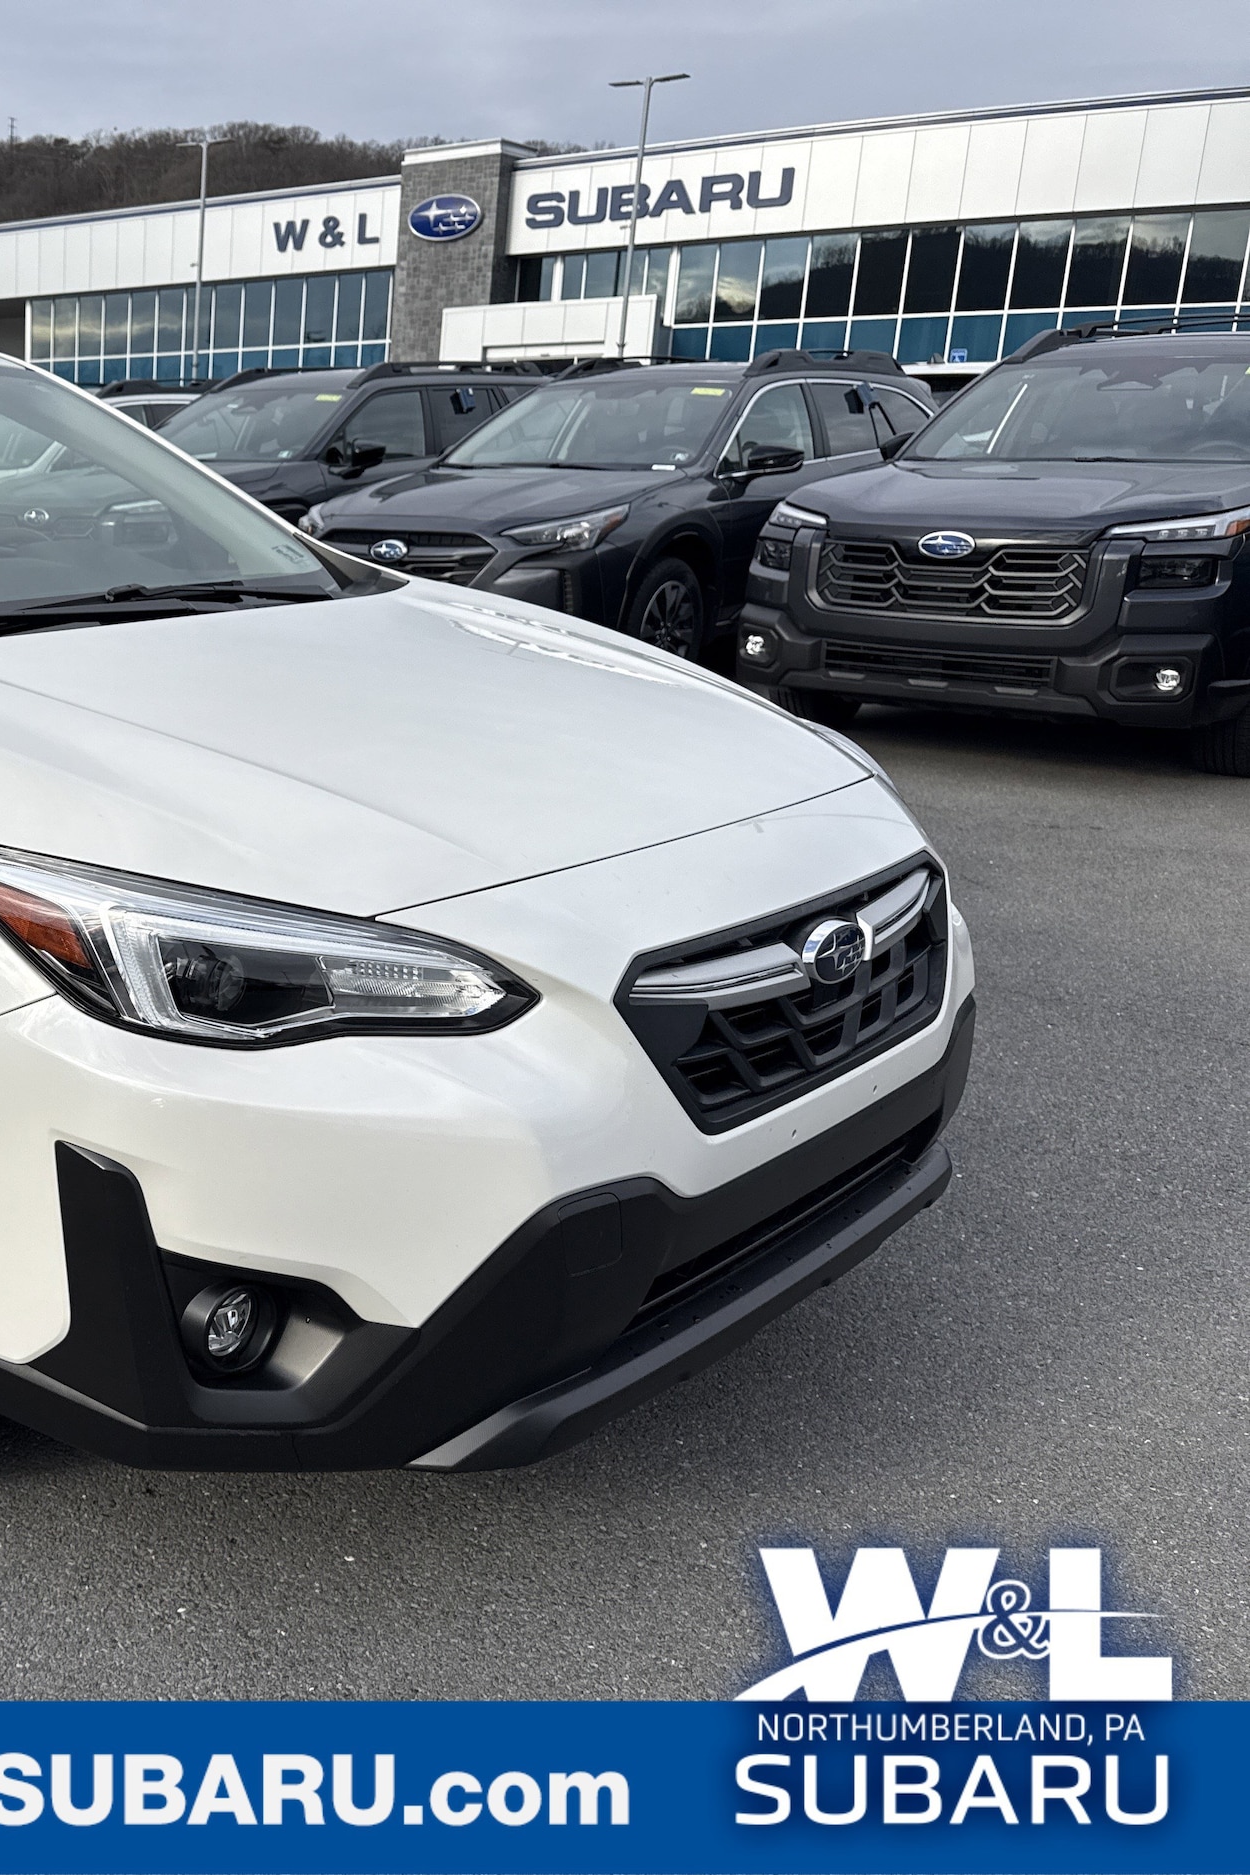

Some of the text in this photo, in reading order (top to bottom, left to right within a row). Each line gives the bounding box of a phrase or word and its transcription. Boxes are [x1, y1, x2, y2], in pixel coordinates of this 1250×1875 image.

[525, 167, 795, 229] SUBARU
[274, 213, 381, 253] W & L
